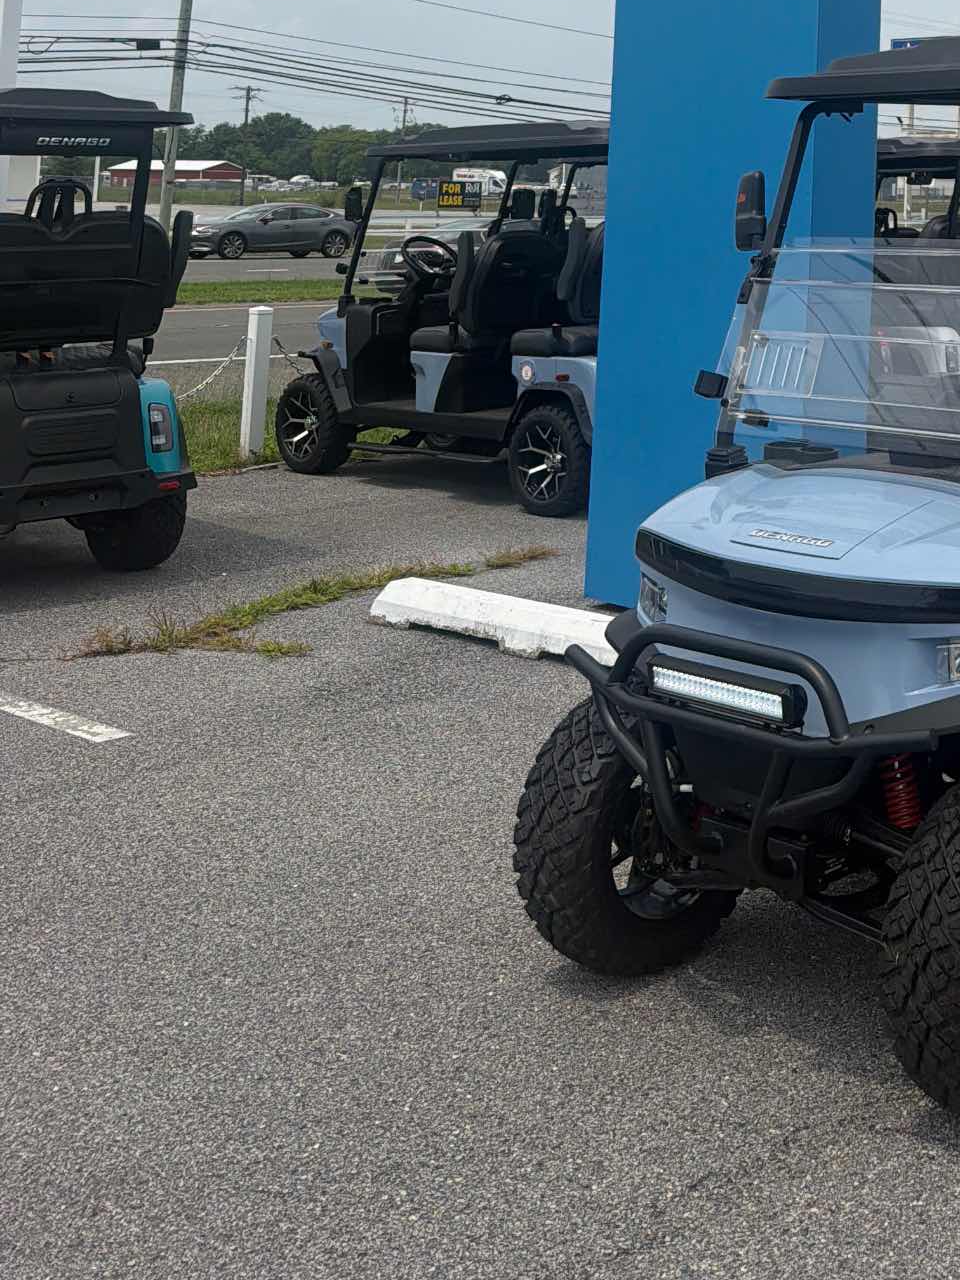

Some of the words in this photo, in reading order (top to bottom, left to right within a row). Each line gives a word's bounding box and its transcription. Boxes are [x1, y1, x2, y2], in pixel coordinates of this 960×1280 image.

[36, 137, 111, 146] DENAGO
[442, 183, 461, 193] FOR
[439, 195, 463, 206] LEASE
